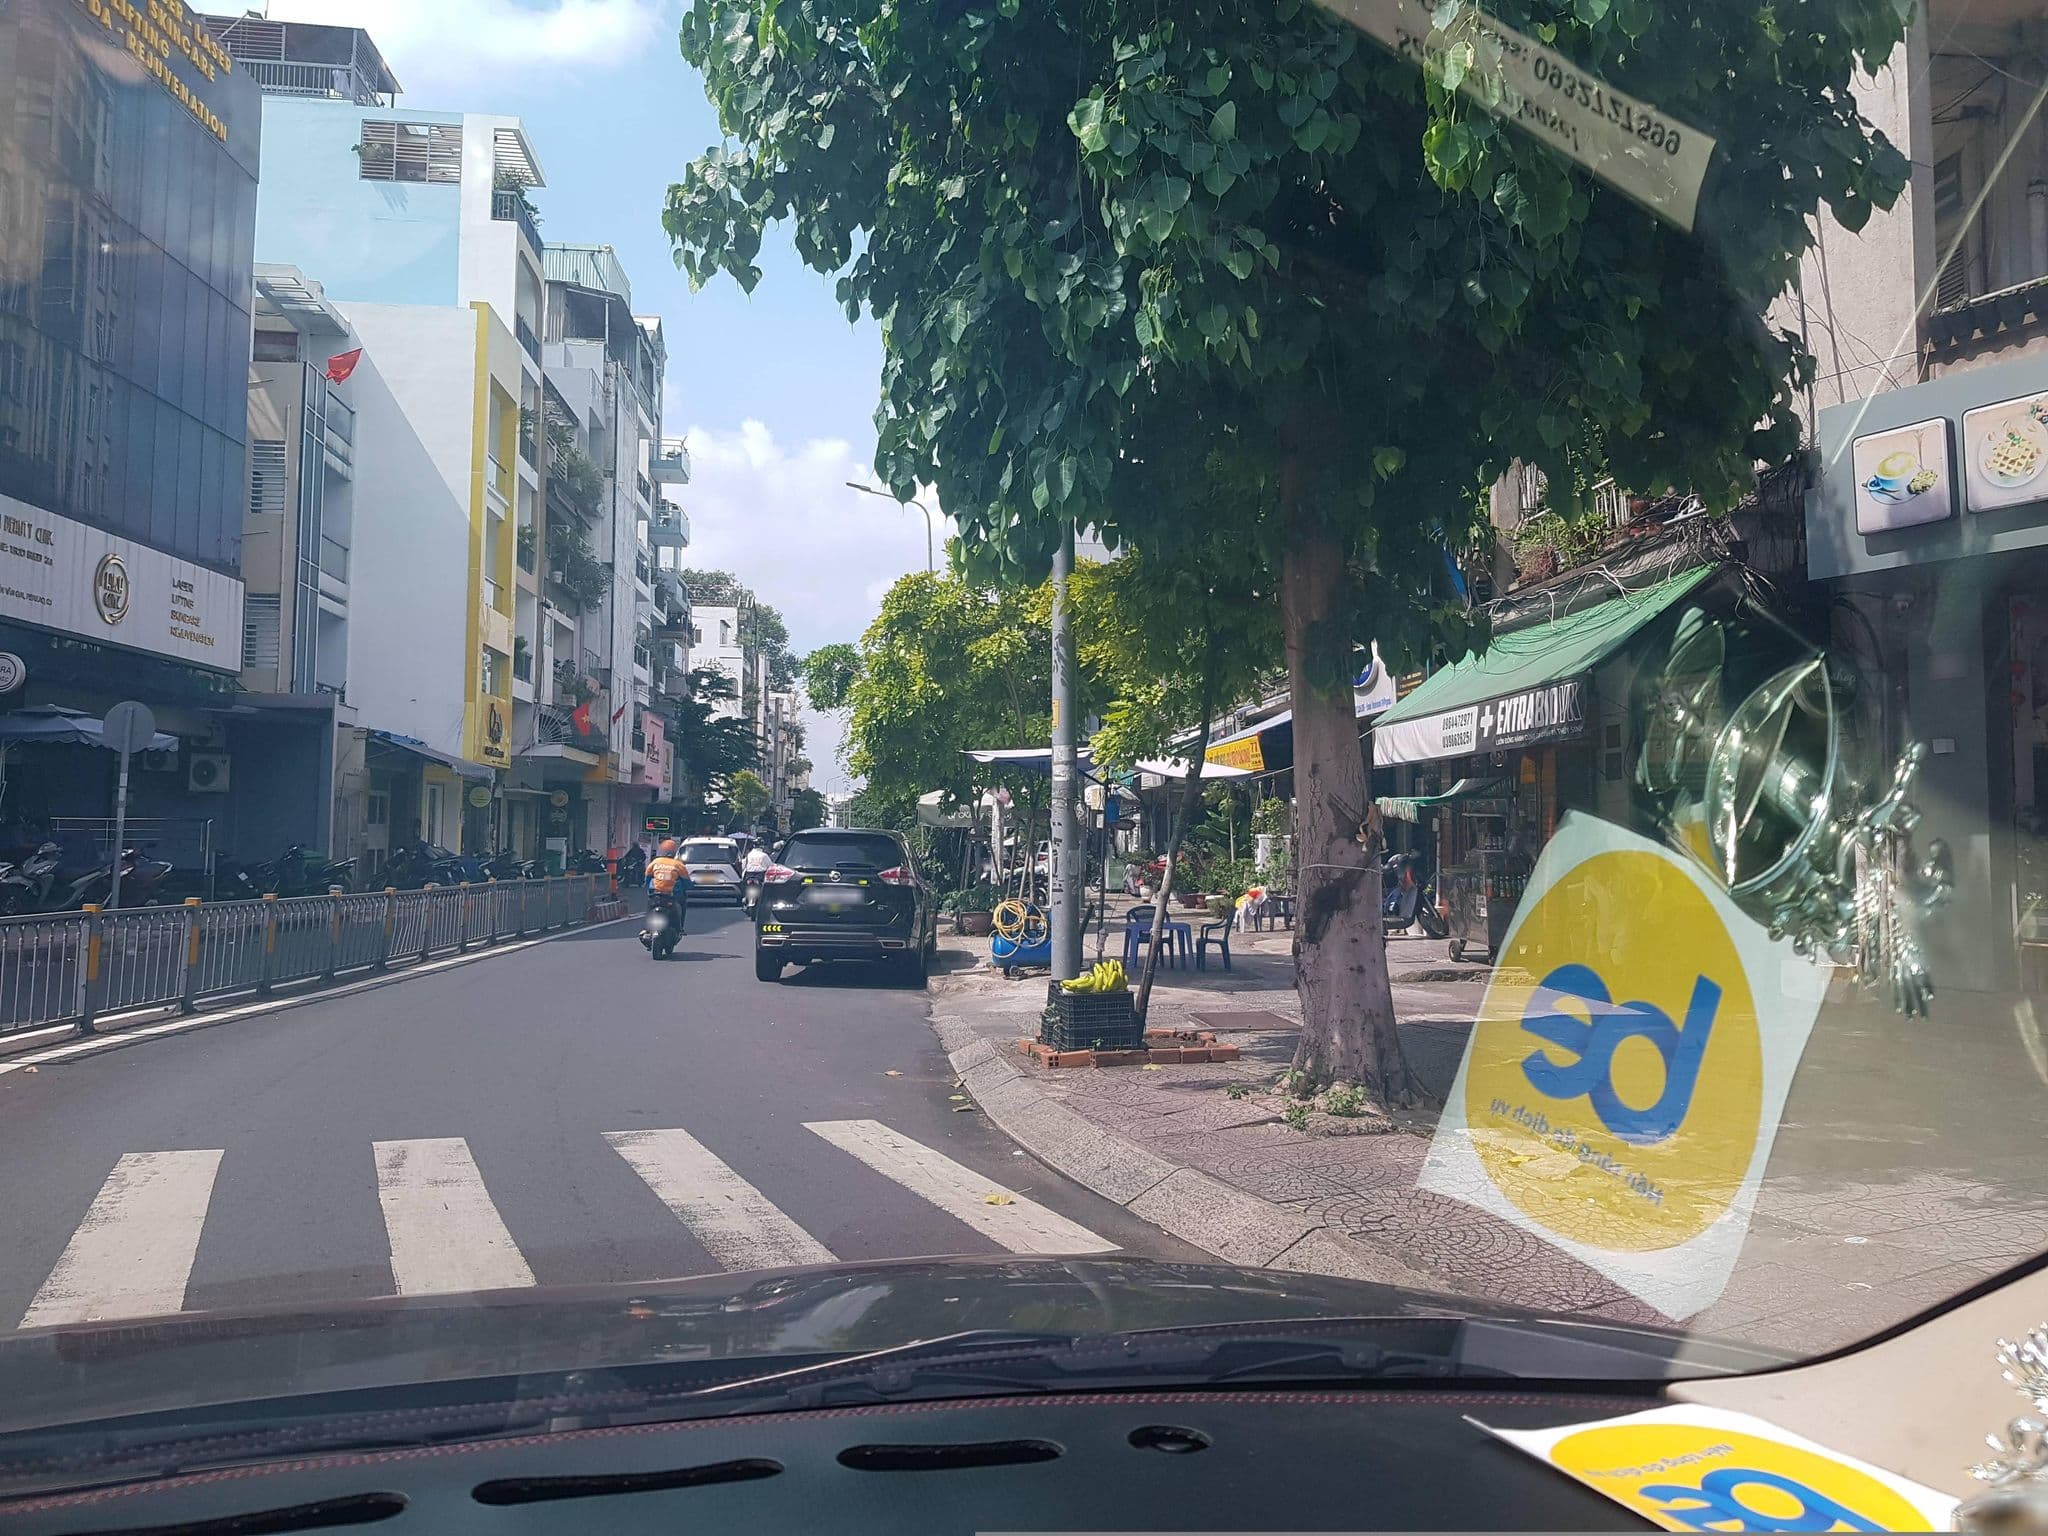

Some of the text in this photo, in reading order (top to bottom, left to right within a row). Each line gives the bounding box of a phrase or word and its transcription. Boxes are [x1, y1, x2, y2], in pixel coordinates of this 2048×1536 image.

[148, 0, 216, 83] SKINCARE
[194, 23, 232, 75] LASER
[126, 30, 227, 142] REJUVENATION
